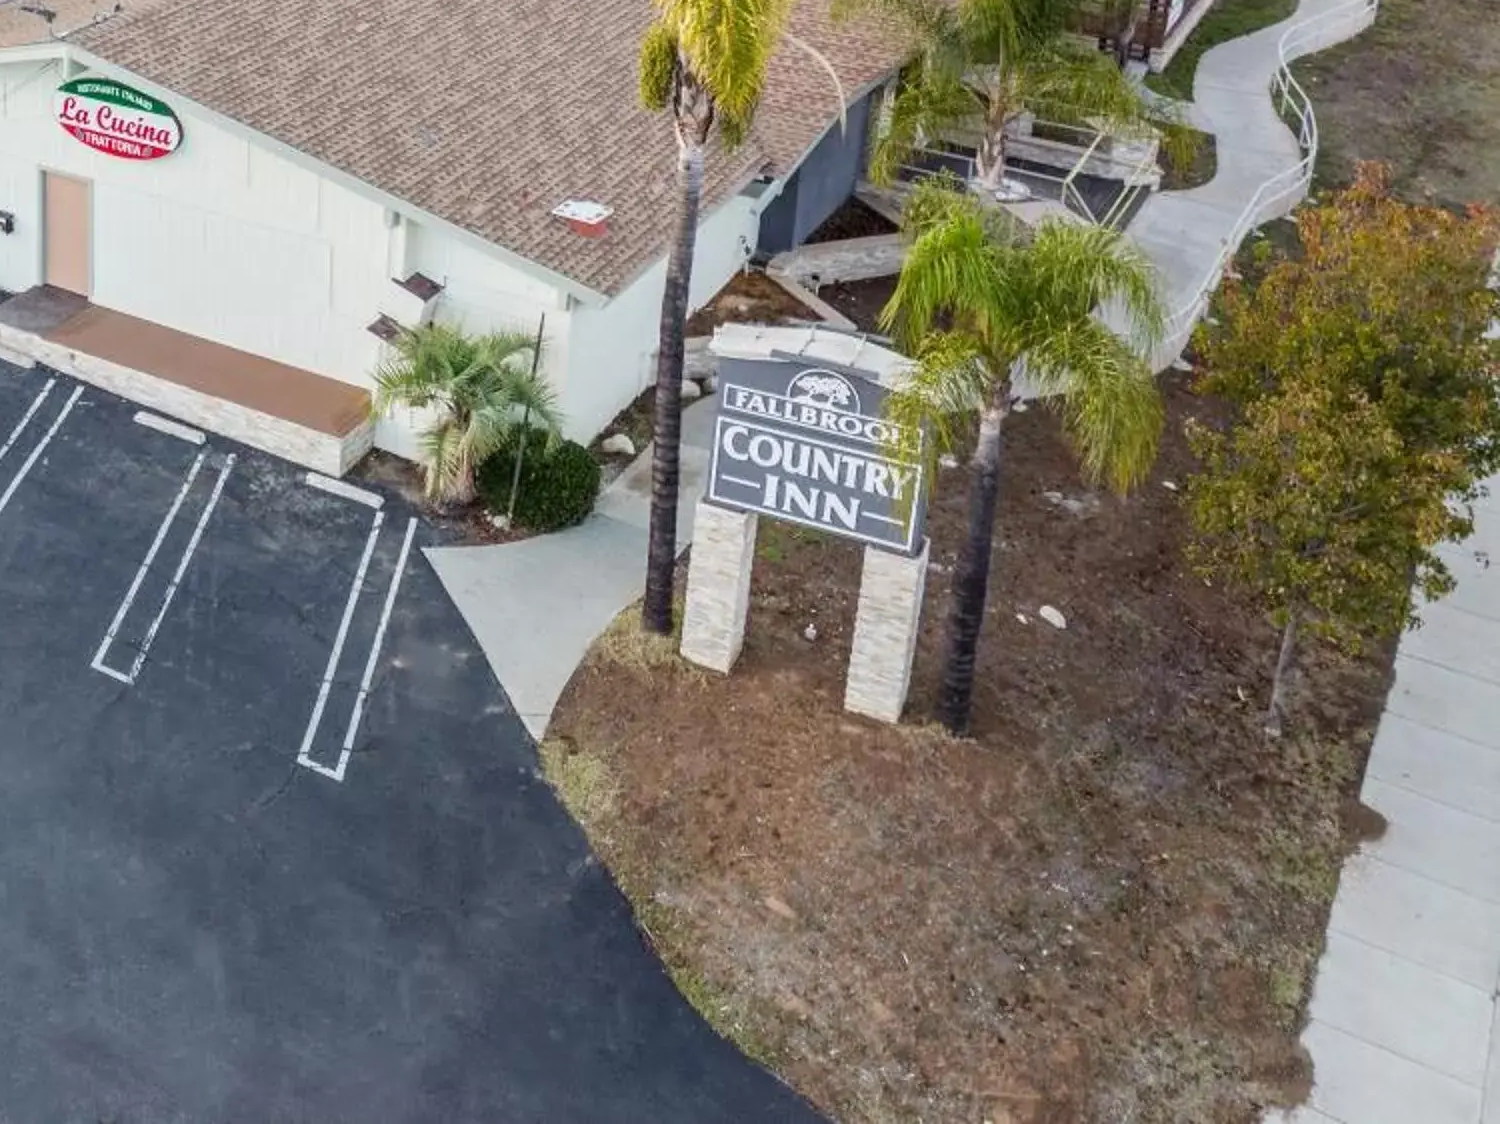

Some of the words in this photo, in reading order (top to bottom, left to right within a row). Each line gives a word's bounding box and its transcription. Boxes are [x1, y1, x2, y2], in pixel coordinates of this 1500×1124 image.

[60, 97, 90, 124] La
[96, 105, 171, 145] Cucina
[85, 131, 141, 156] TRATTORIA
[722, 425, 912, 501] COUNTRY
[762, 474, 861, 529] INN
